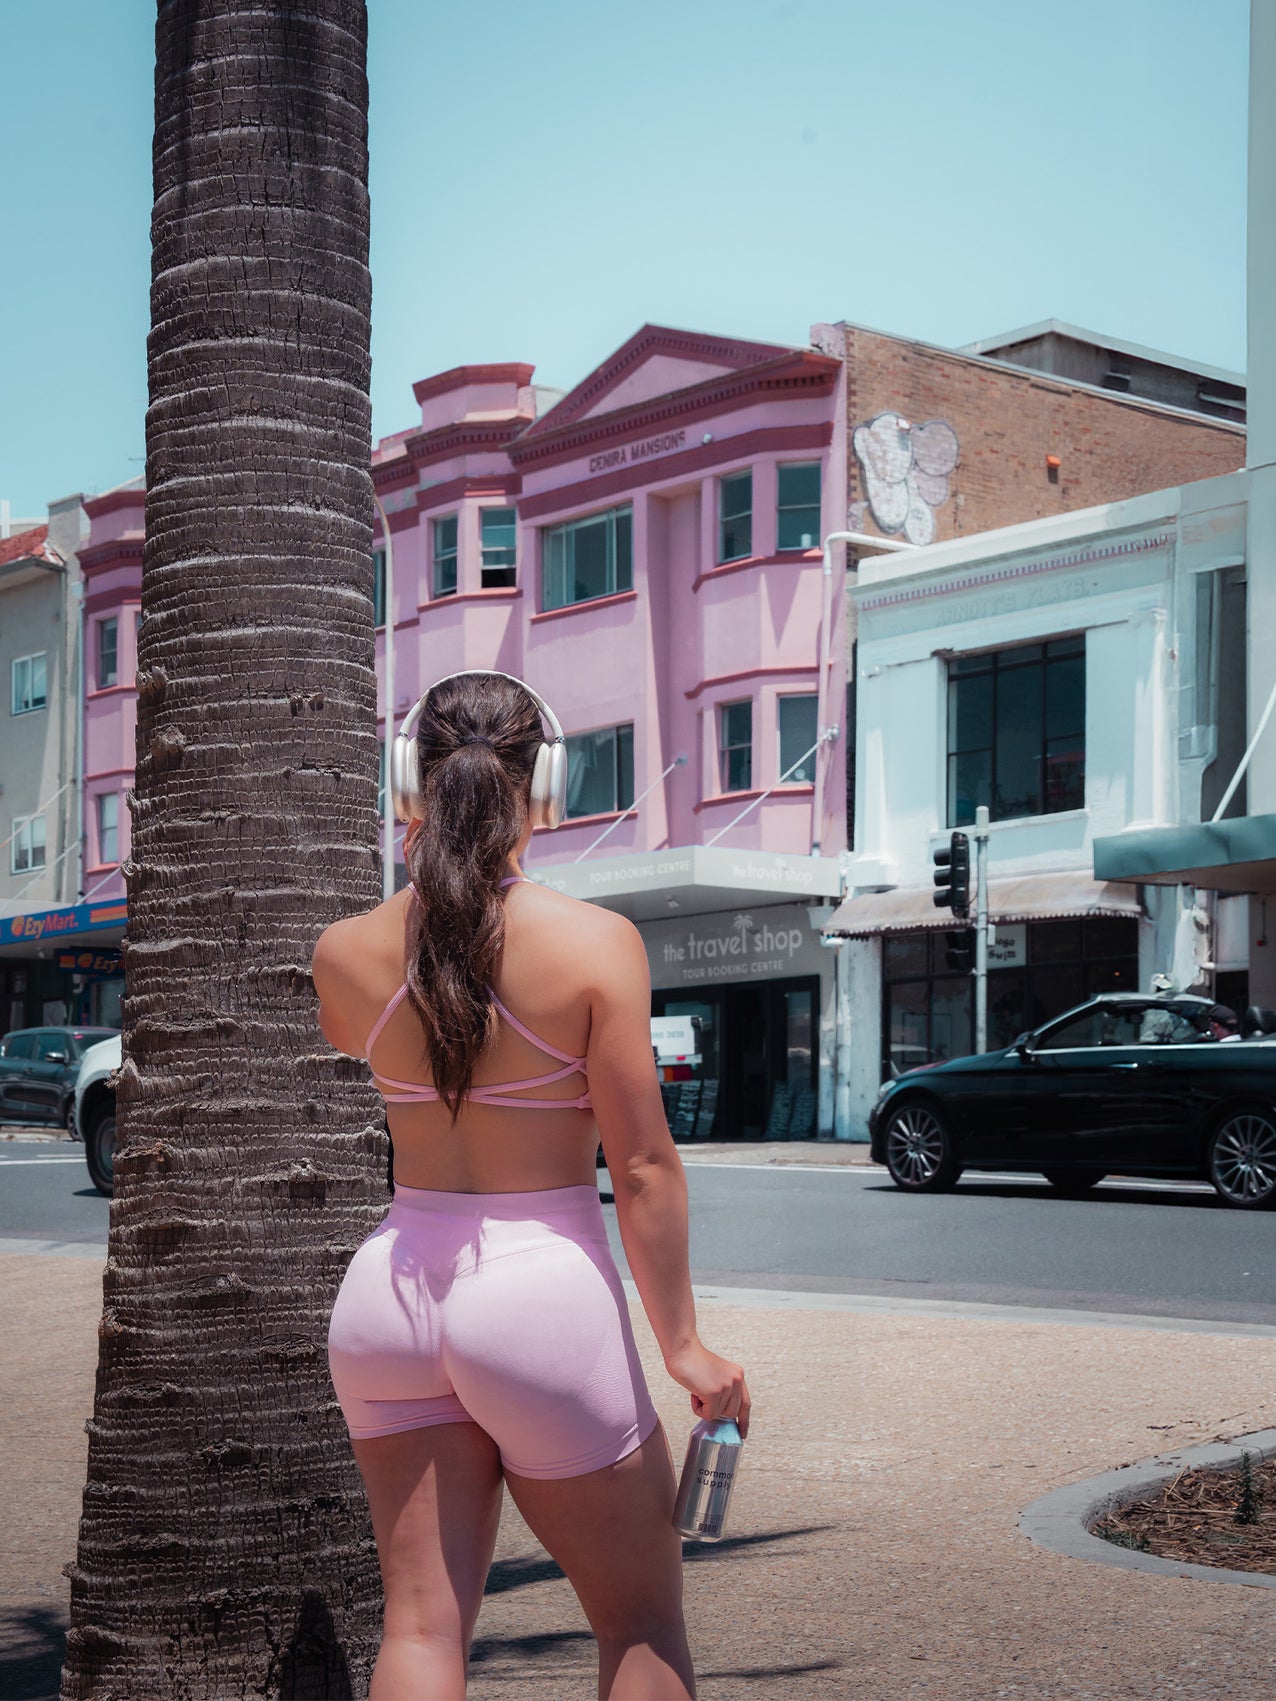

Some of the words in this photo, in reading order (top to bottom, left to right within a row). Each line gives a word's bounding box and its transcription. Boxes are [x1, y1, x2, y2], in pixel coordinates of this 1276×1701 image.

[631, 430, 685, 460] MANSIONS
[589, 870, 612, 884] TOUR
[614, 863, 655, 882] BOOKING
[657, 859, 691, 876] CENTRE
[747, 861, 783, 882] travel
[785, 866, 813, 887] shop
[663, 943, 686, 962] the
[687, 920, 747, 960] travel
[754, 924, 803, 957] shop
[682, 967, 705, 980] TOUR
[708, 963, 747, 977] BOOKING
[751, 959, 784, 973] CENTRE
